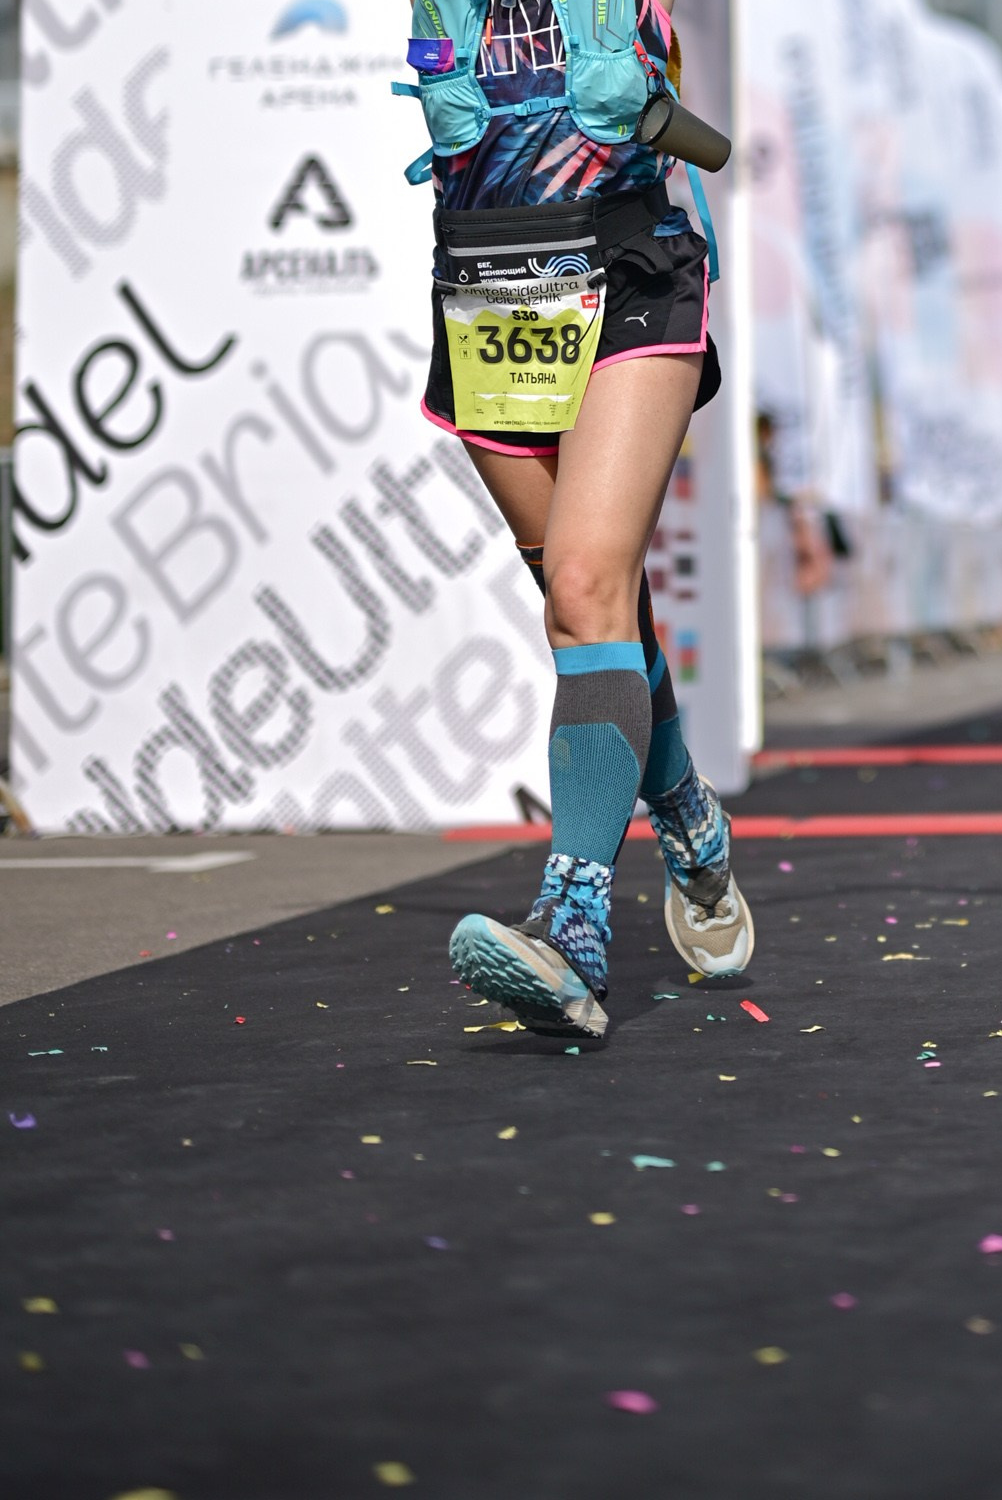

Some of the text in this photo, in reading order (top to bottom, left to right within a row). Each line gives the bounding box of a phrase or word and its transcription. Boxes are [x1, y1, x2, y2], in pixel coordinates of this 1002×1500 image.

[477, 261, 493, 270] БЕГ,
[479, 266, 527, 278] МЕНЯЮЩИЙ
[460, 280, 579, 297] WhiteBrideUltra
[486, 293, 562, 306] Gelendzhik
[512, 310, 539, 322] S30
[476, 323, 582, 365] 3638
[509, 372, 557, 385] ТАТЬЯНА
